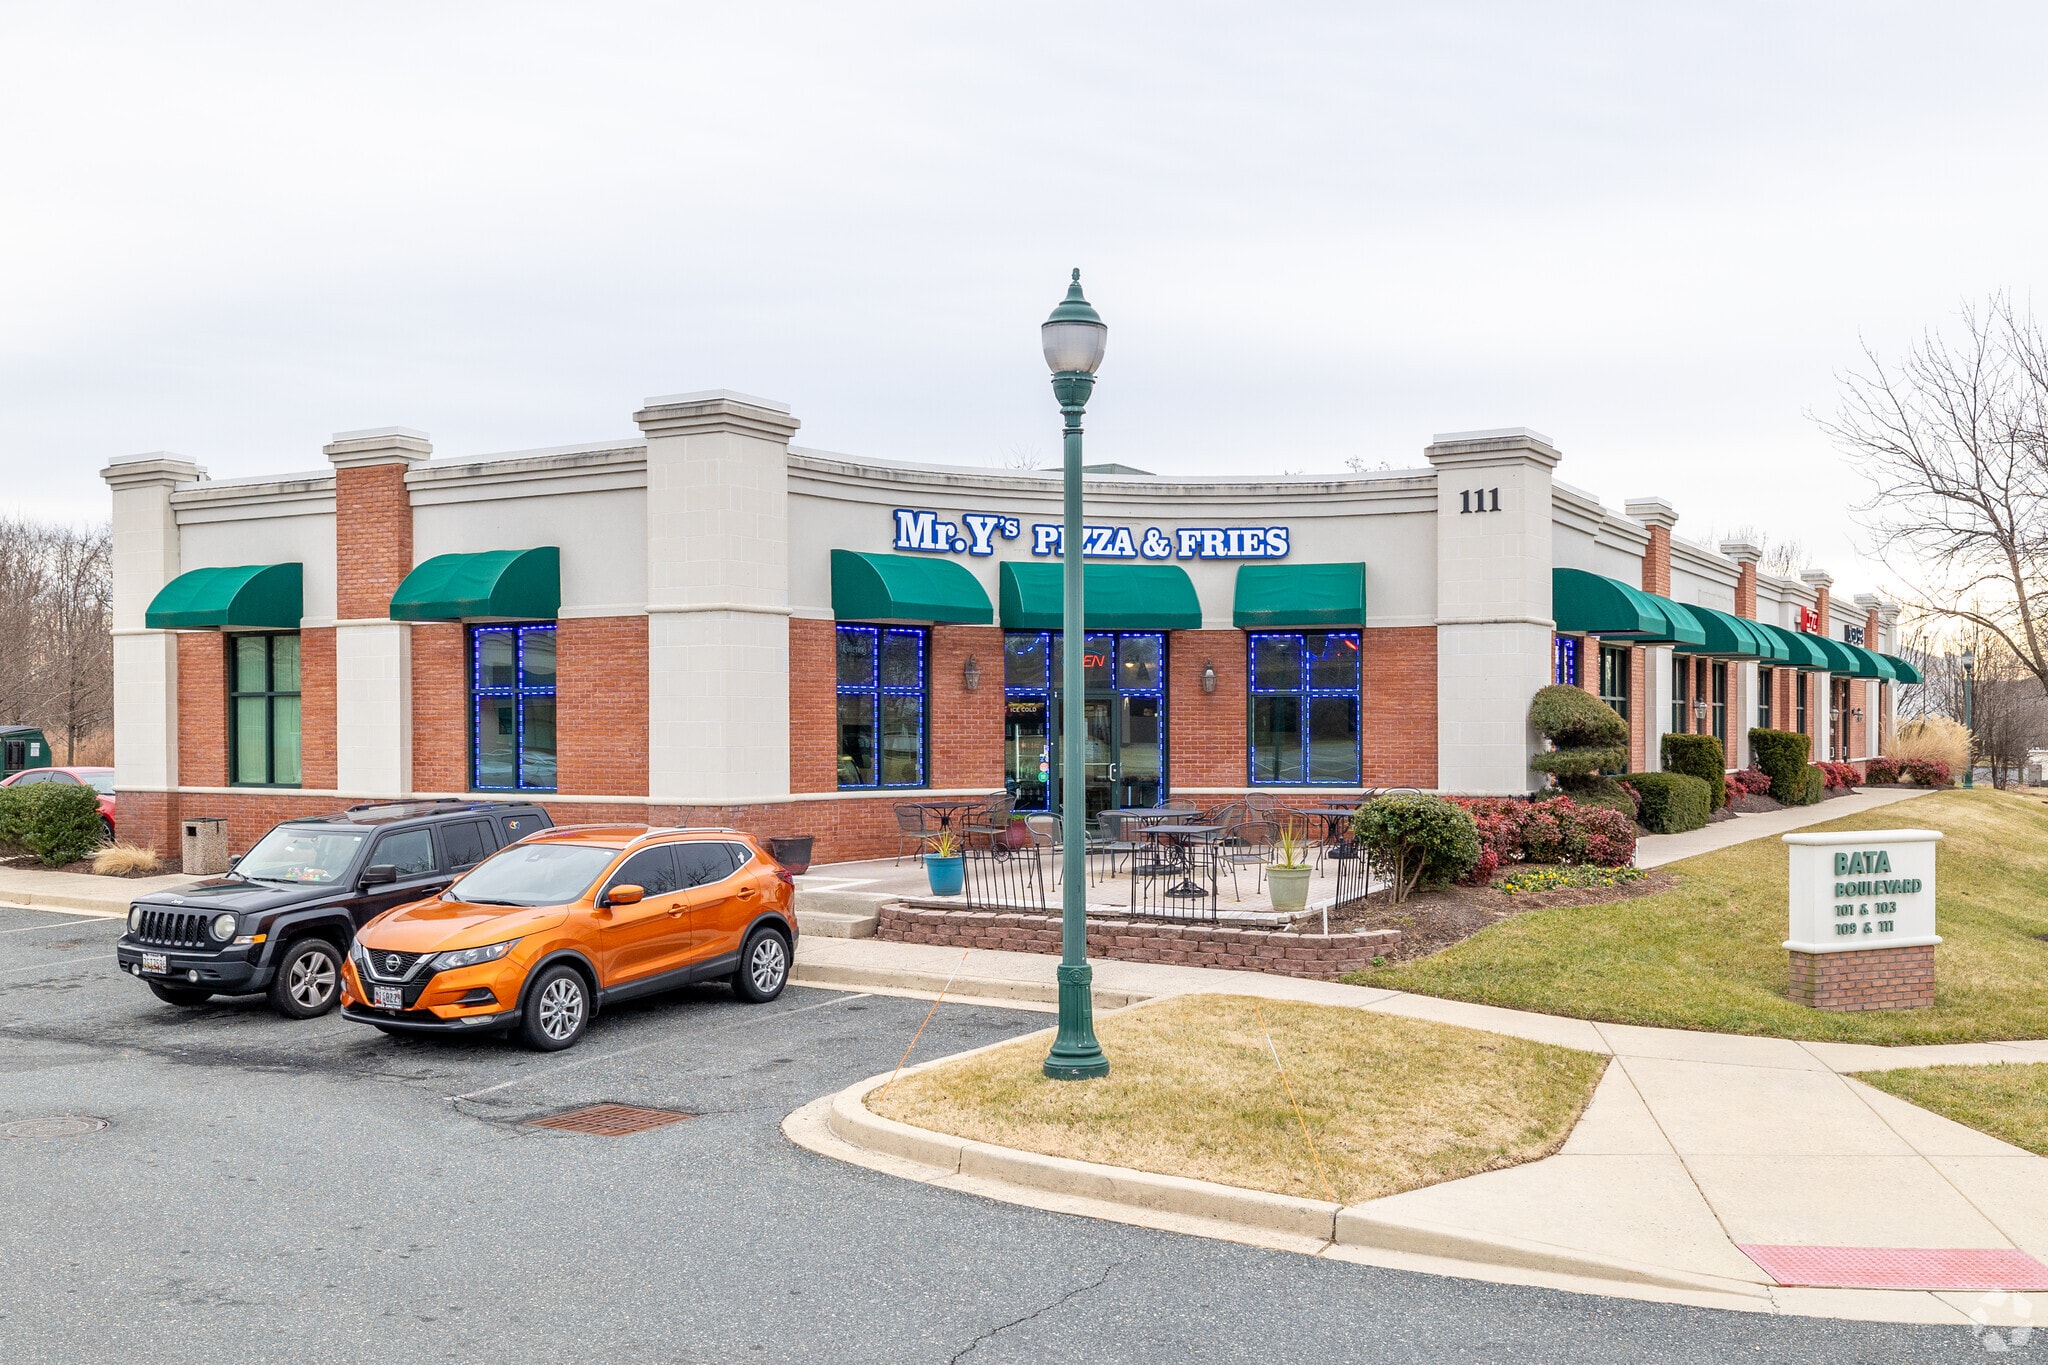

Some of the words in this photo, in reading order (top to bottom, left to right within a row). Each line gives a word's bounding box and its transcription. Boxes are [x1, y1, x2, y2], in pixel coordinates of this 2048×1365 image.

[1459, 487, 1502, 514] 111
[1141, 527, 1173, 560] &
[1176, 526, 1290, 560] FRIES
[1834, 850, 1892, 876] BATA
[1835, 879, 1922, 897] BOULEVARD
[1835, 904, 1854, 917] 101
[1860, 903, 1869, 916] &
[1875, 901, 1897, 914] 103
[1835, 922, 1857, 936] 109
[1863, 921, 1873, 934] &
[1878, 920, 1894, 933] 111
